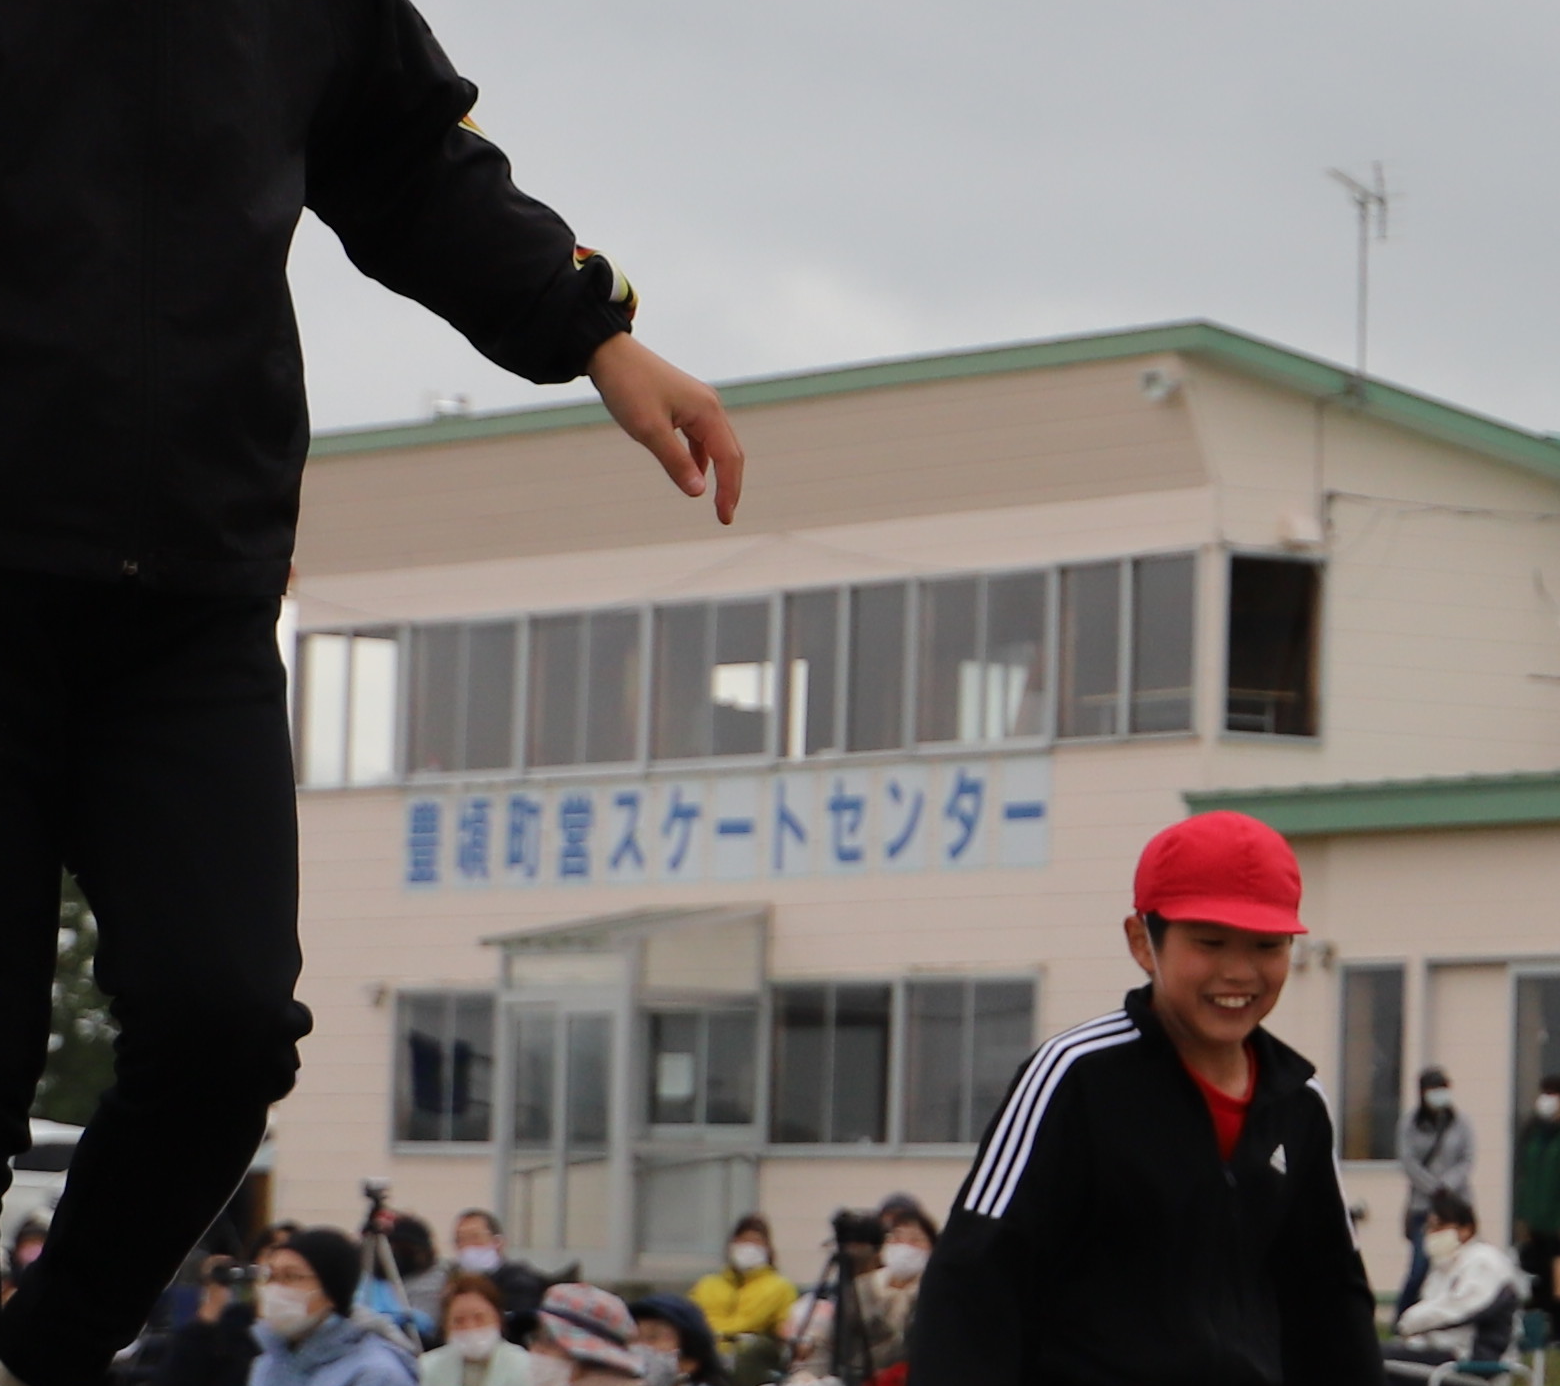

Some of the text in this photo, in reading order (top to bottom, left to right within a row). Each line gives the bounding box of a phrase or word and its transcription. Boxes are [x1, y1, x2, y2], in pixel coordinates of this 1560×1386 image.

[407, 767, 1047, 883] 豊頃町営スケートセンター
